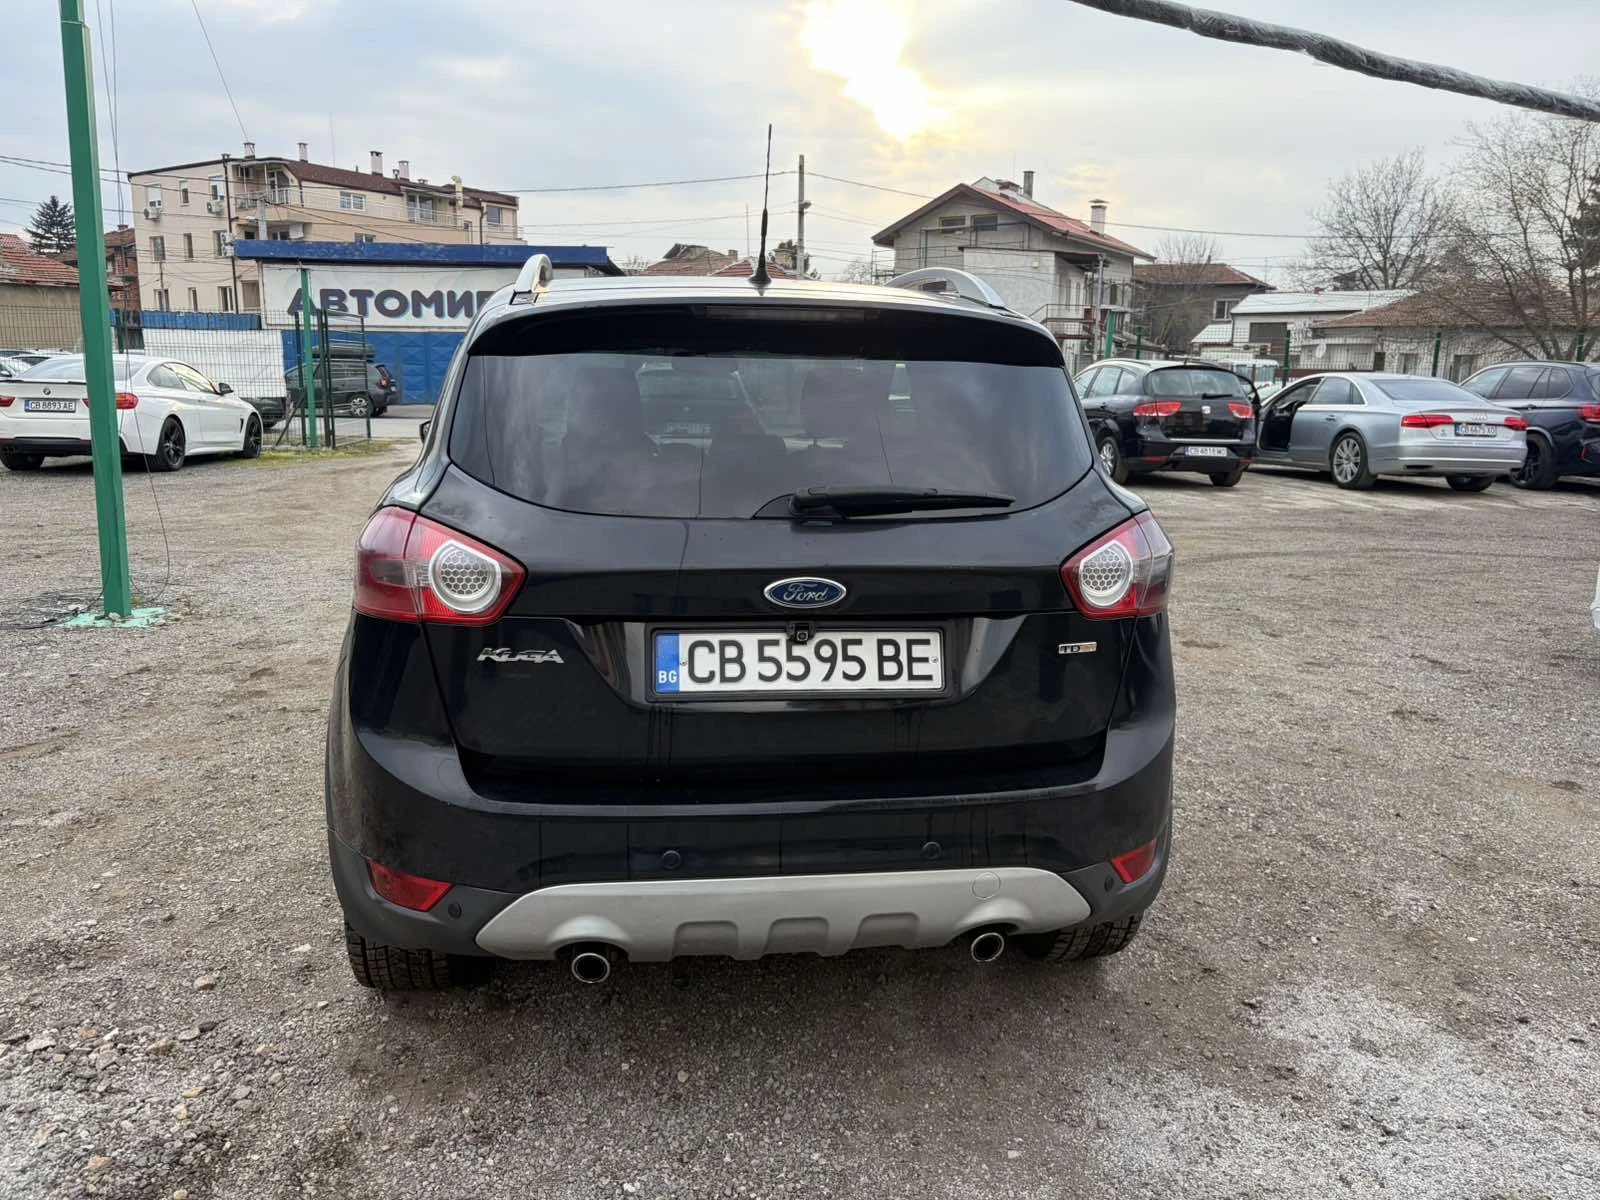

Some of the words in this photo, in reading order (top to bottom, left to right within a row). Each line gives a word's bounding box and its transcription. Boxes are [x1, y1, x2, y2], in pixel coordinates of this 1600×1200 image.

[783, 582, 829, 601] Ford
[687, 639, 747, 684] CB
[757, 638, 867, 682] 5595
[876, 638, 934, 682] BE
[658, 670, 677, 683] BG
